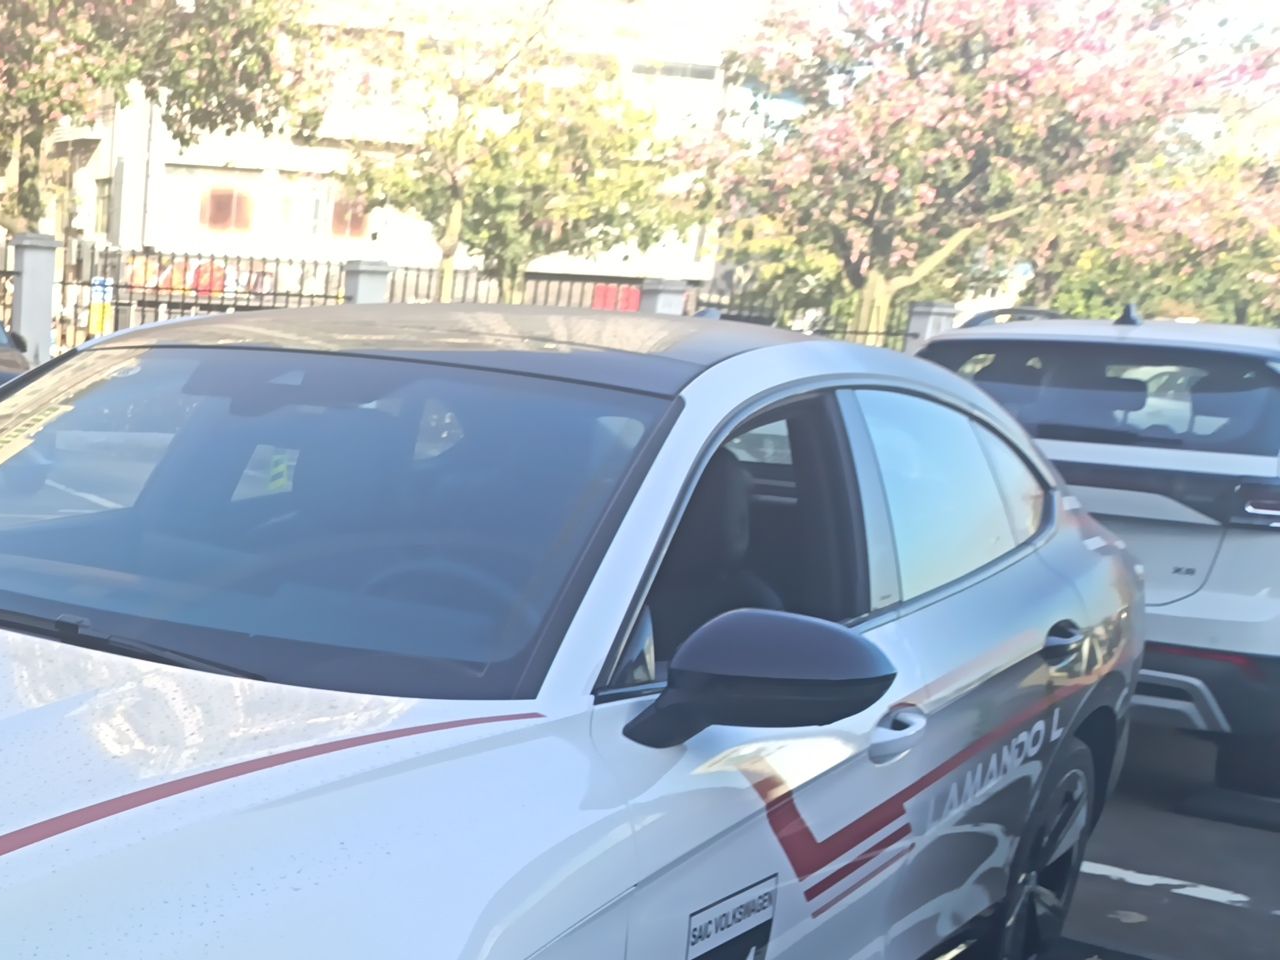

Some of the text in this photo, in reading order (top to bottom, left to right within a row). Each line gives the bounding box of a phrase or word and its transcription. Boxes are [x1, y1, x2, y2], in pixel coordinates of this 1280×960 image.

[926, 707, 1065, 829] LAMANDO L
[690, 891, 774, 946] SAIC VOLKSWAGEN
